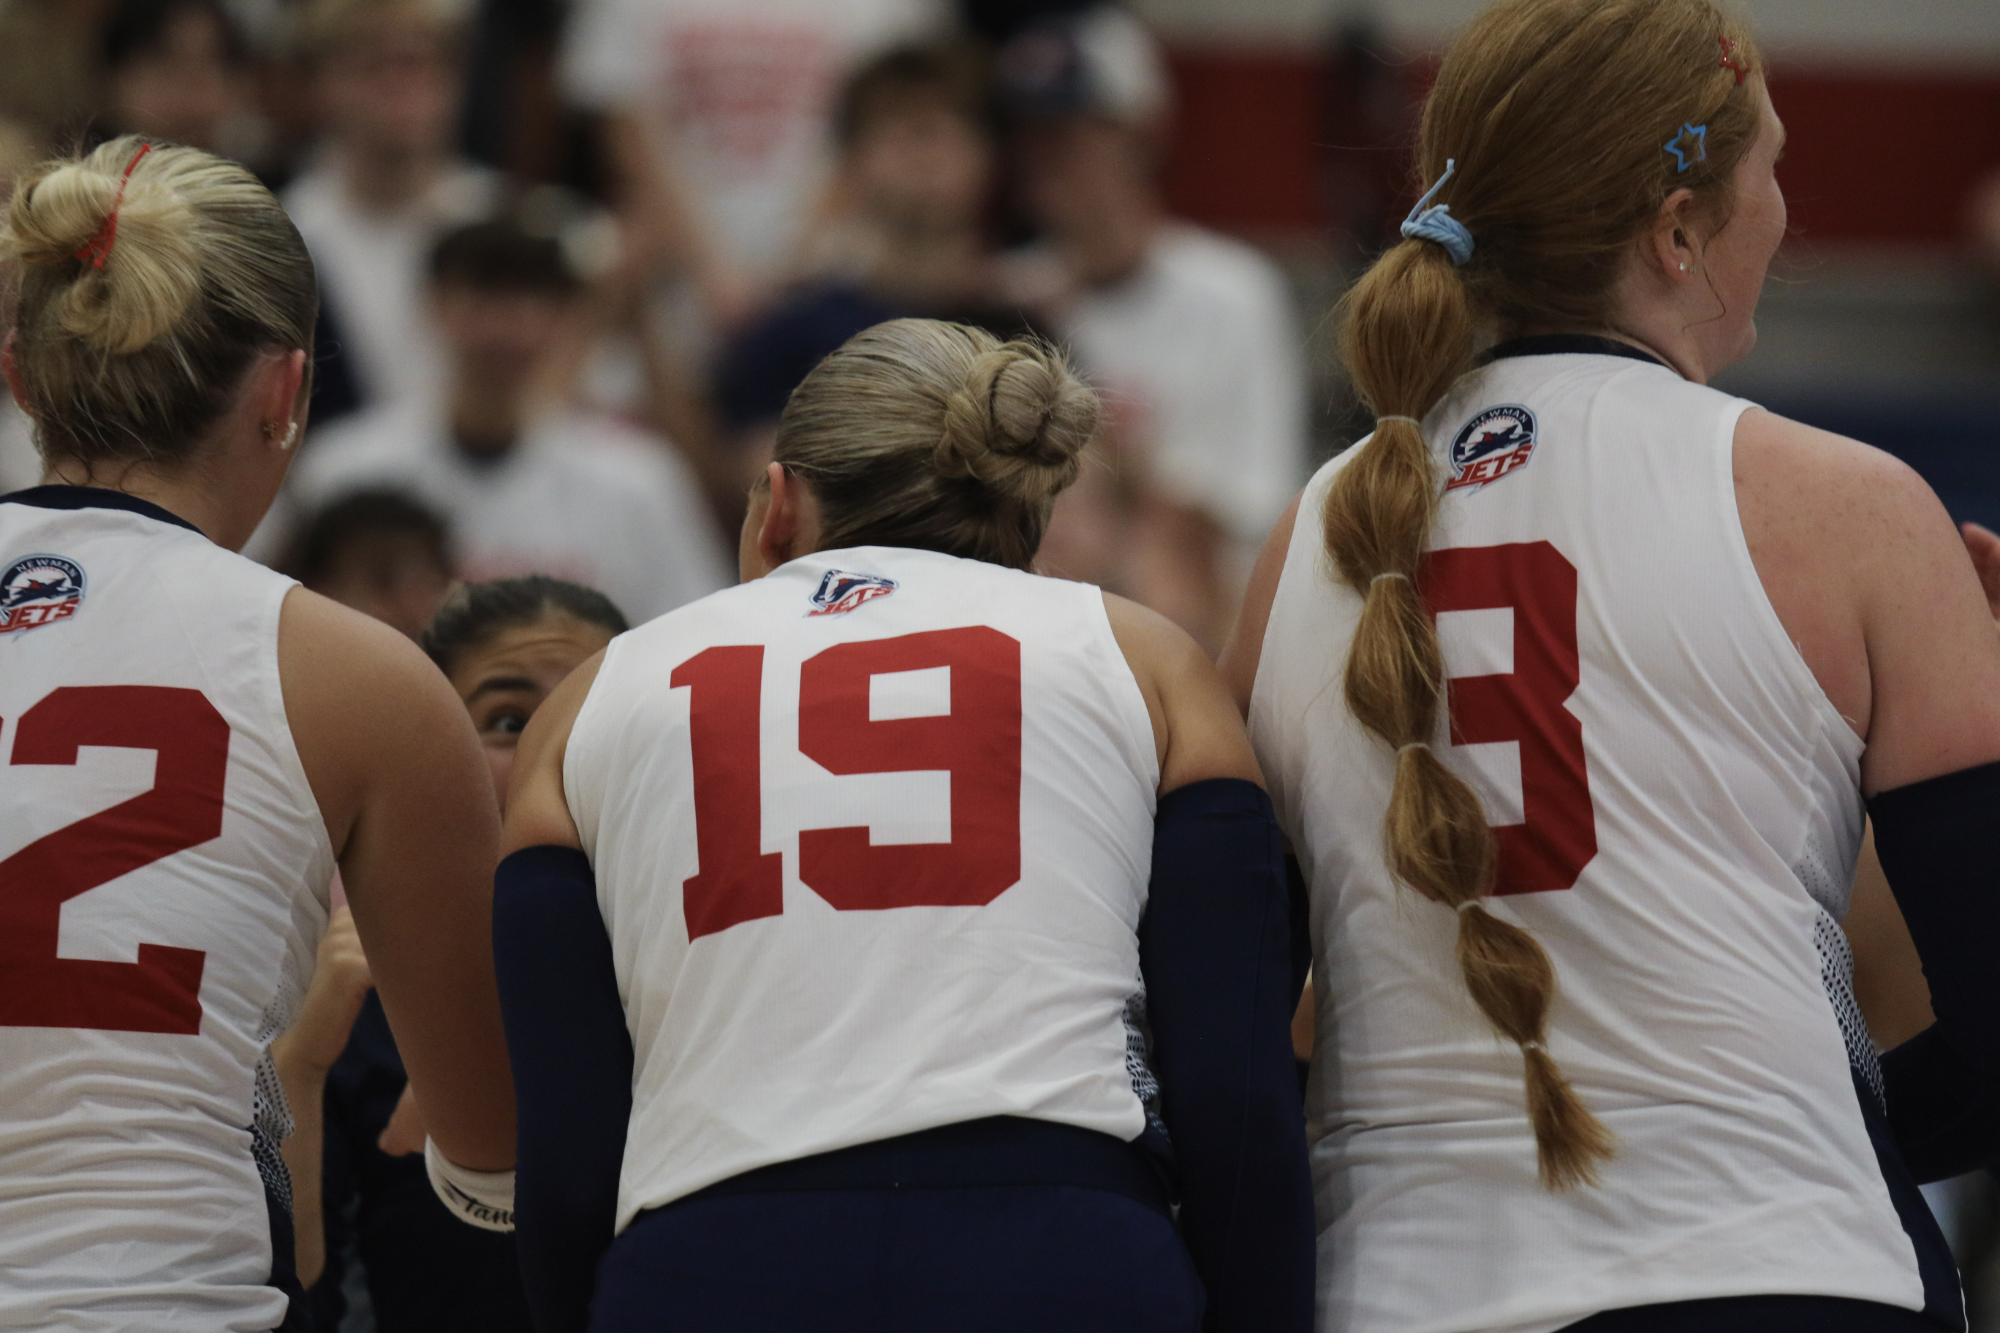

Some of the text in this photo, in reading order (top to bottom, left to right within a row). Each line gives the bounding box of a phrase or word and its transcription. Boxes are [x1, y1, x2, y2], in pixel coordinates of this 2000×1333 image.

[1471, 408, 1528, 428] NEWMAN
[1445, 444, 1533, 492] JETS
[0, 598, 81, 633] JETS
[807, 587, 895, 616] JETS
[1409, 540, 1598, 900] 3
[670, 625, 1021, 944] 19
[0, 685, 230, 1035] 2
